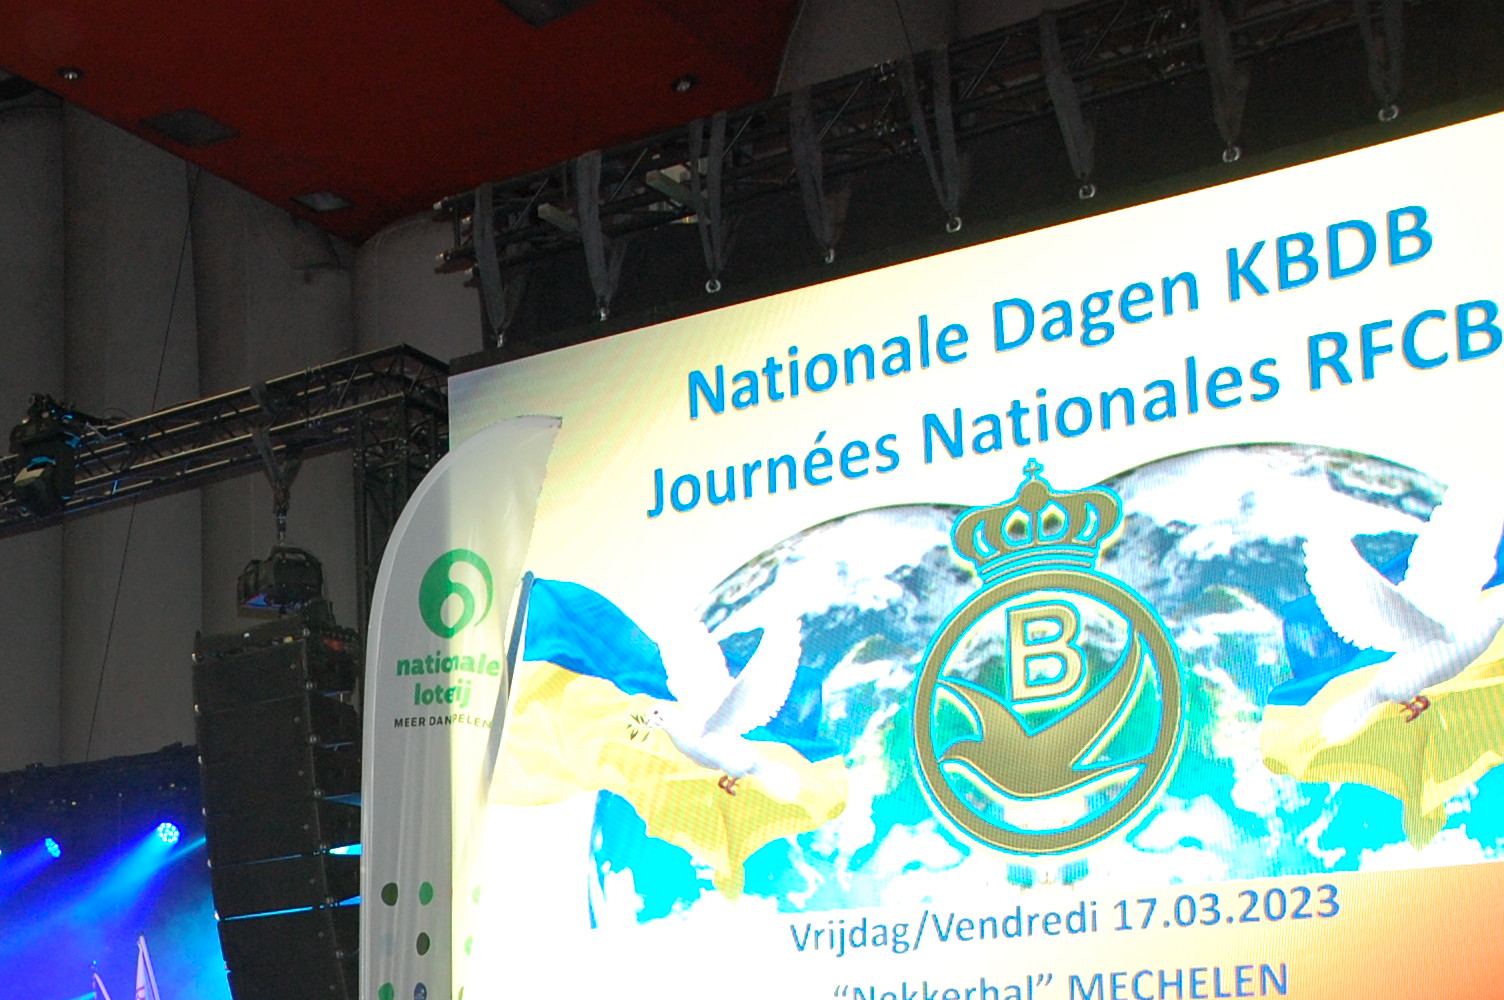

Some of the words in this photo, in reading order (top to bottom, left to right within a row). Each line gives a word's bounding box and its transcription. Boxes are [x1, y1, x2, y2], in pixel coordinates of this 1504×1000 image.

[688, 314, 969, 420] Nationale
[992, 267, 1200, 347] Dagen
[1226, 204, 1435, 303] KBDB
[646, 430, 900, 518] Journées
[921, 354, 1281, 464] Nationales
[1307, 297, 1502, 392] RFCB
[1006, 600, 1086, 704] B
[394, 716, 426, 728] MEER
[429, 715, 452, 726] DAN
[452, 713, 492, 729] PELEN
[790, 899, 1098, 956] Vrijdag/Vendredi
[1113, 883, 1341, 932] 17.03.2023
